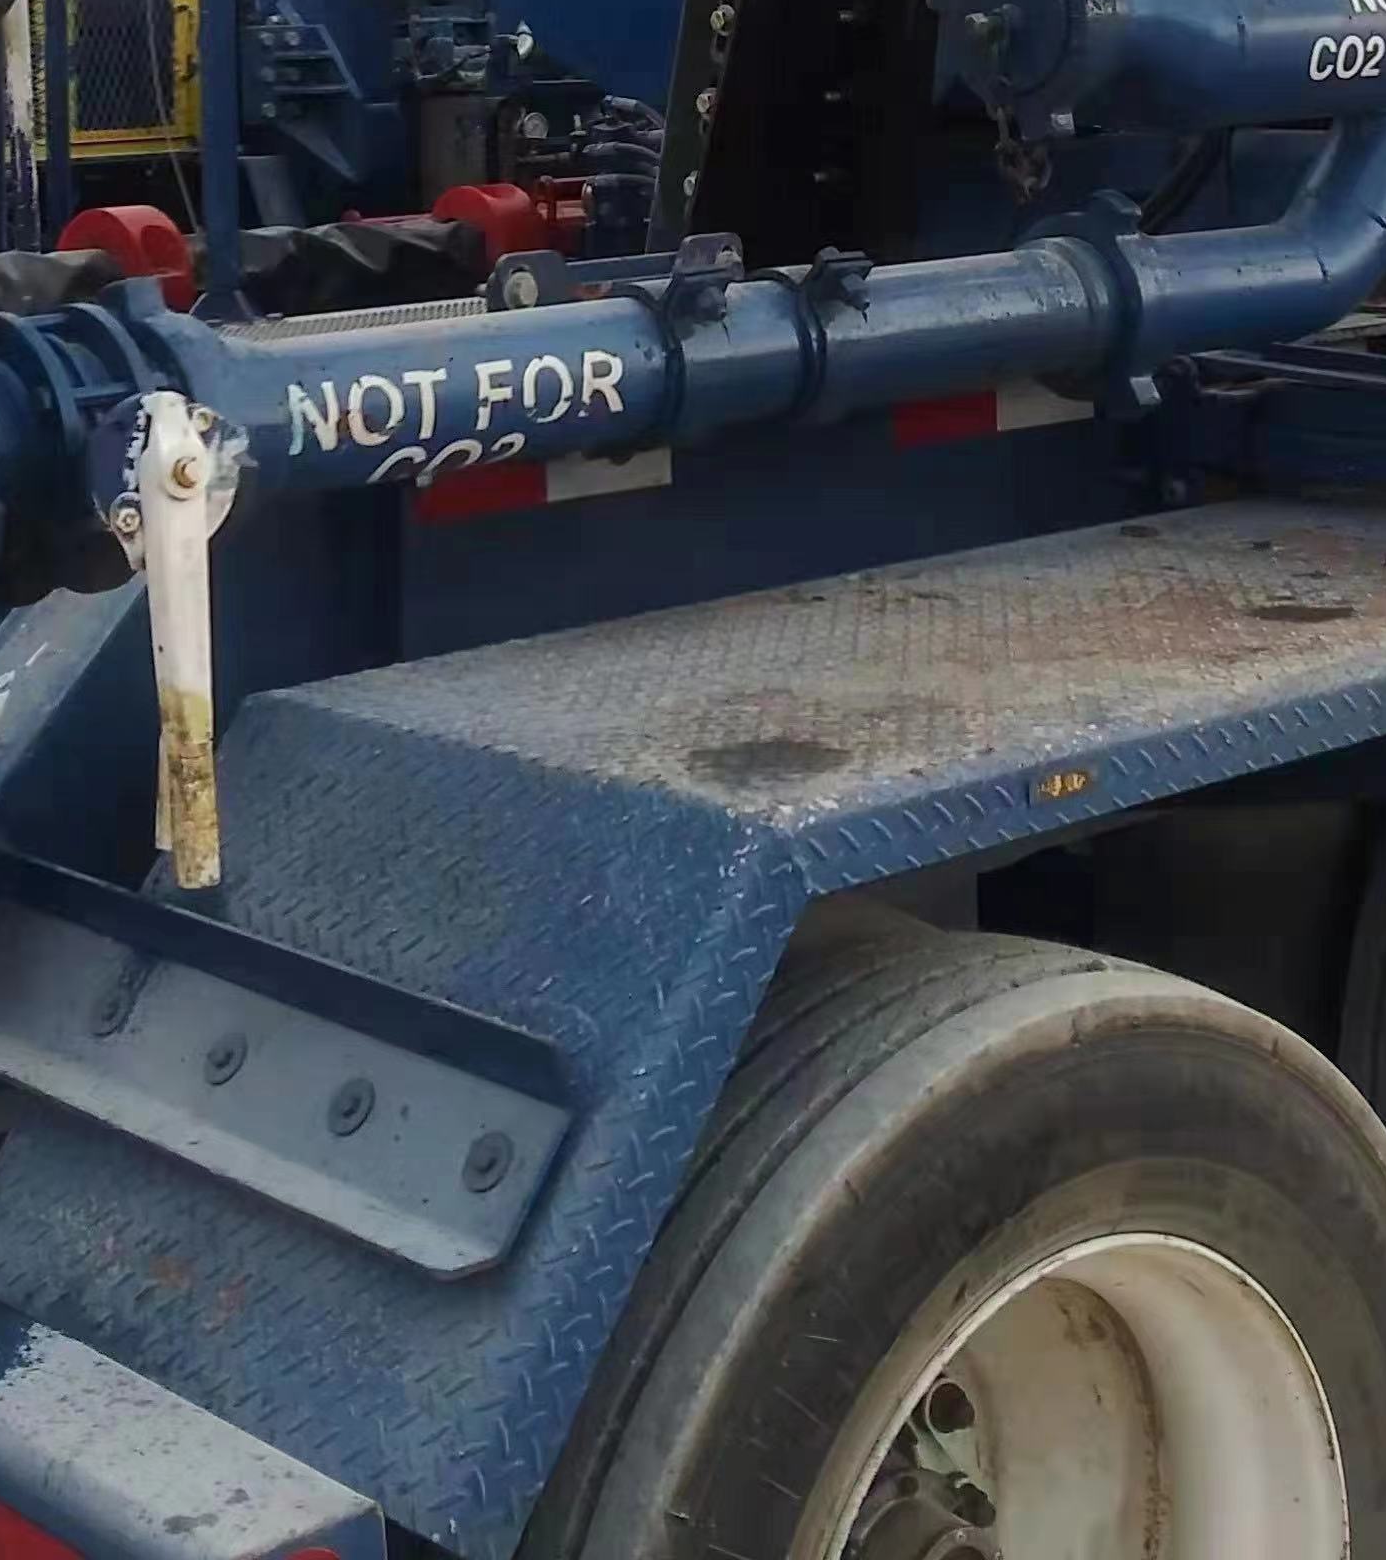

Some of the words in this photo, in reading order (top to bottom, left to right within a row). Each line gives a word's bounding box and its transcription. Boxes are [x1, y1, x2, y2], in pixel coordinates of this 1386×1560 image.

[1309, 35, 1386, 81] CO2
[287, 367, 446, 456] NOT
[474, 349, 625, 431] FOR
